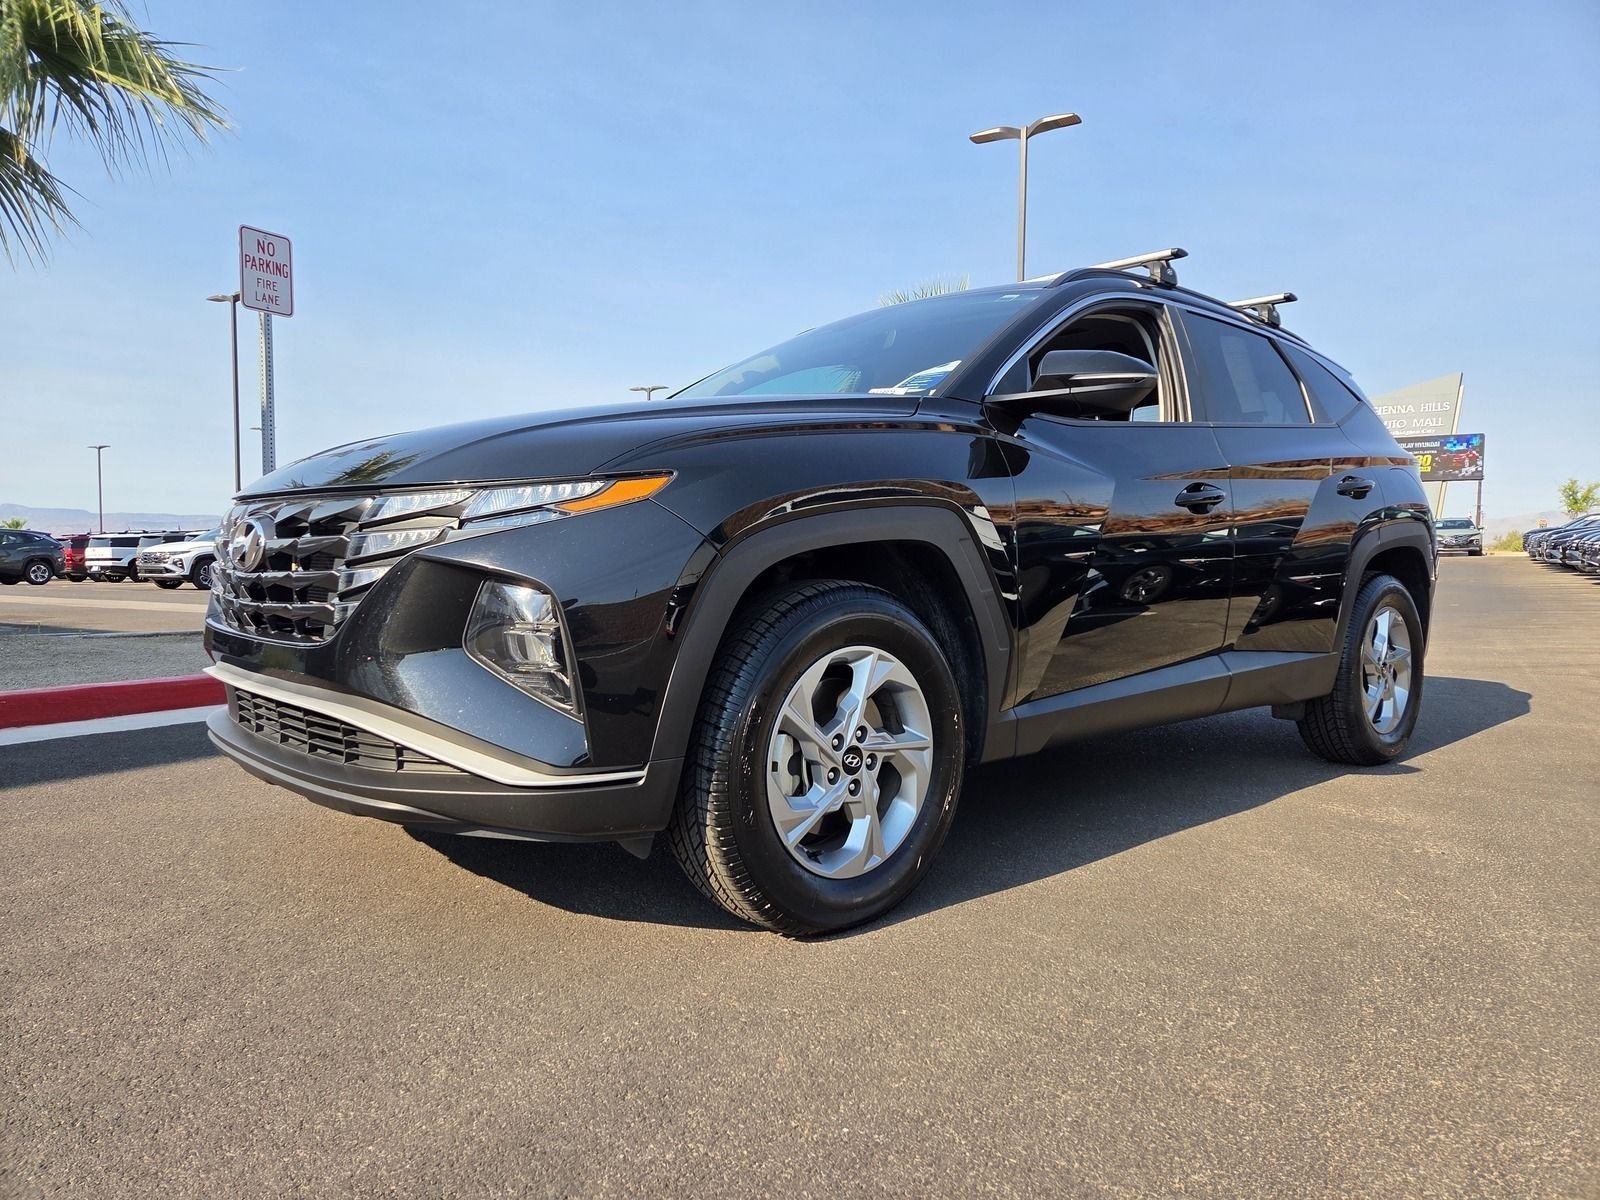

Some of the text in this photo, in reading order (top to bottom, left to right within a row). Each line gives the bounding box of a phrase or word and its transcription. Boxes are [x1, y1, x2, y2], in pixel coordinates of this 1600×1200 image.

[256, 238, 275, 256] NO
[244, 253, 288, 278] PARKING
[256, 278, 278, 292] FIRE
[255, 290, 280, 306] LANE
[1420, 402, 1450, 412] HILLS
[1384, 417, 1444, 429] UTO MALL
